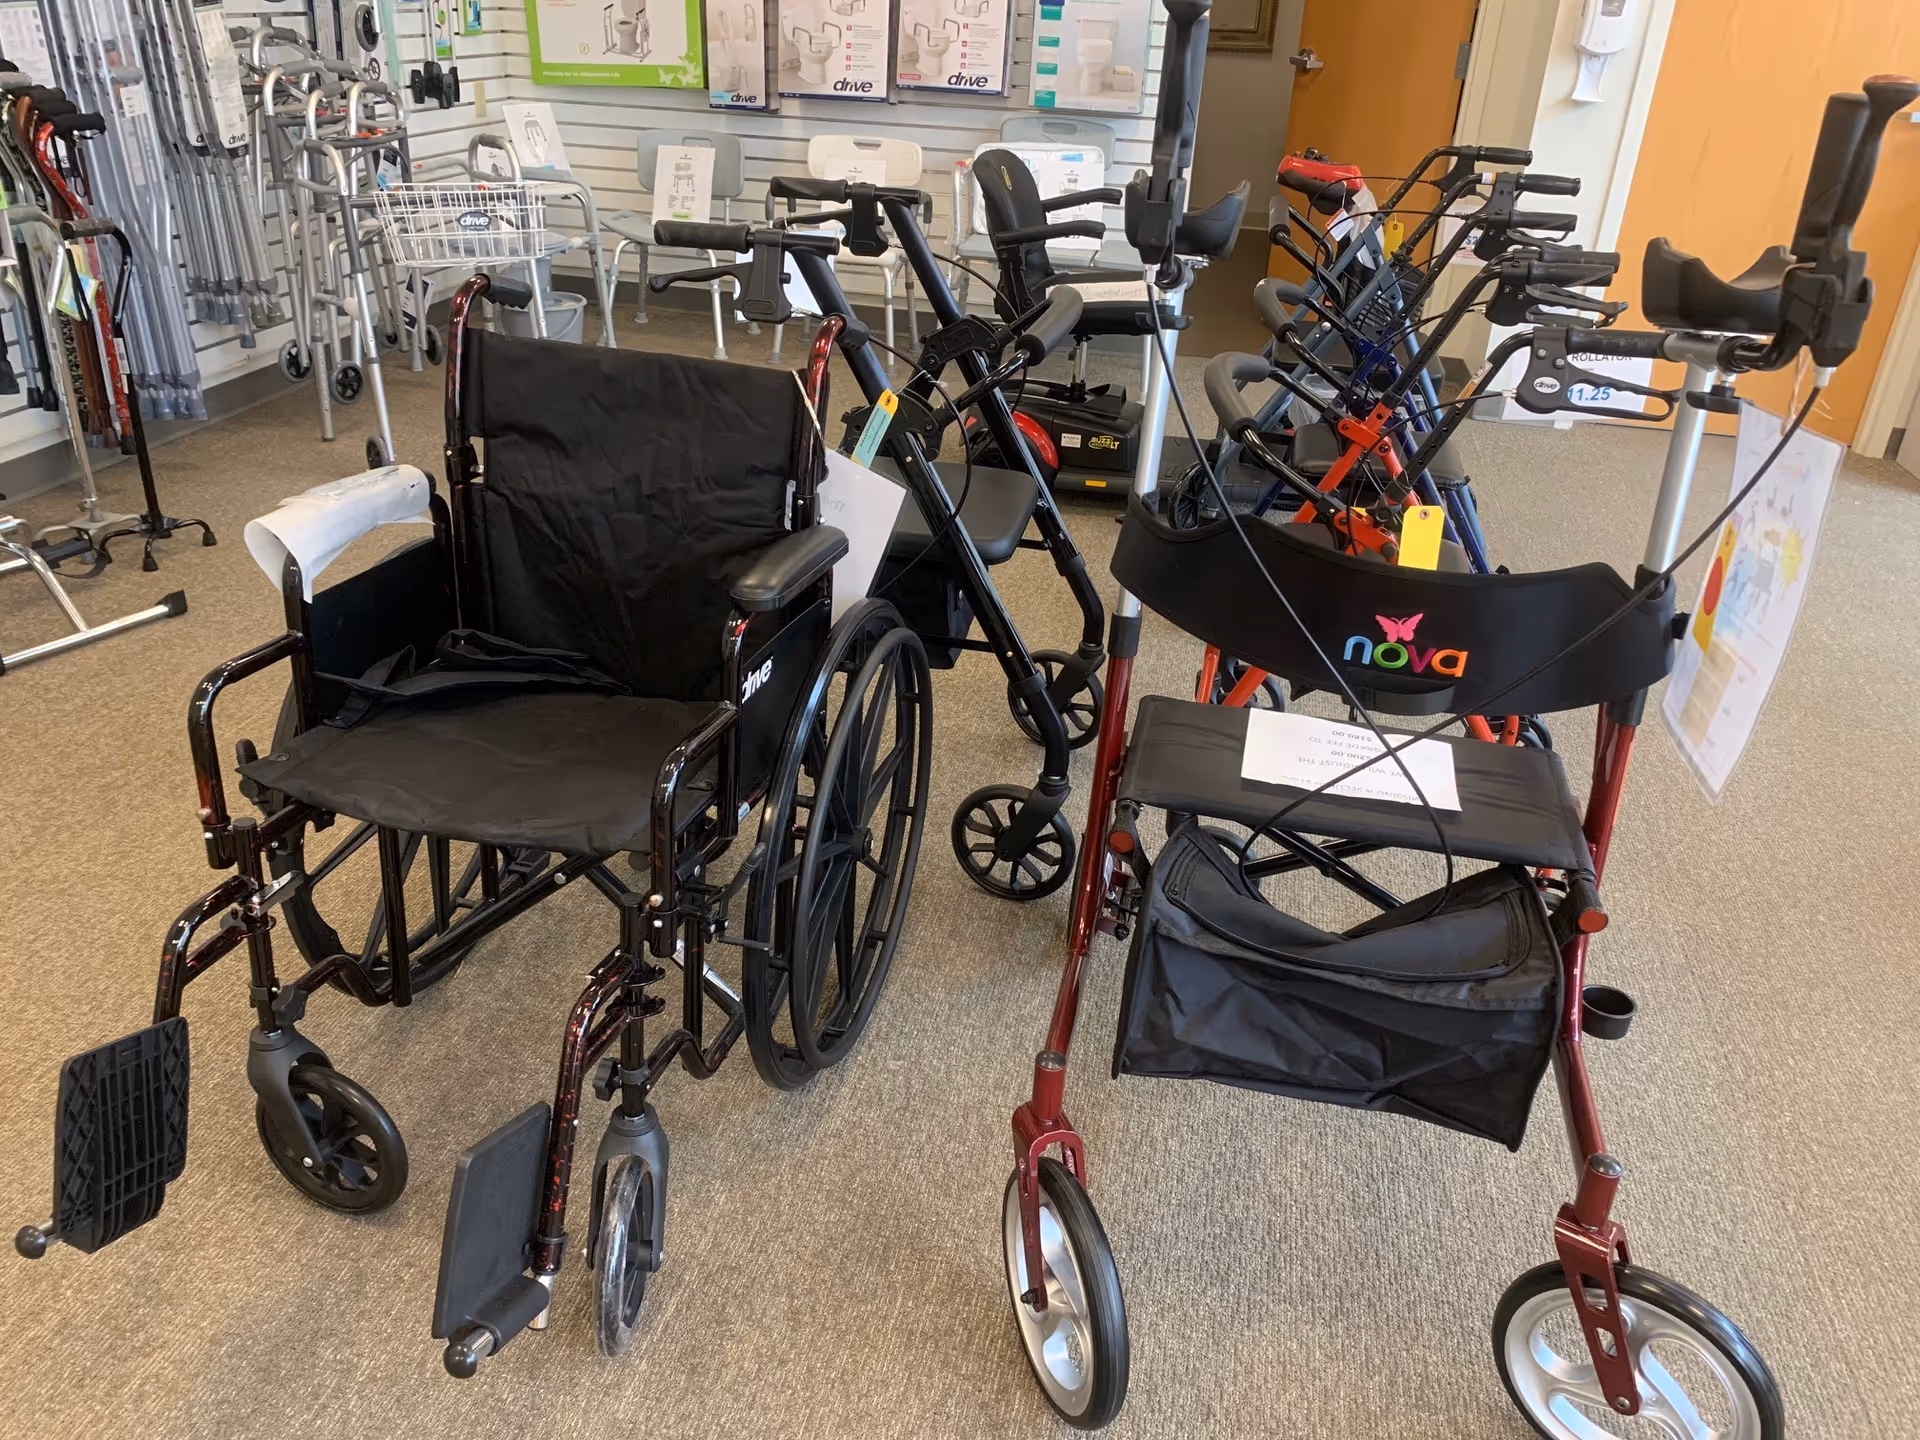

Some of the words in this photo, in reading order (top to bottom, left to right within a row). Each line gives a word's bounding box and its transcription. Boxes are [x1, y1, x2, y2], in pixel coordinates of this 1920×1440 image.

[833, 77, 873, 93] drive
[947, 72, 989, 88] drive
[731, 91, 757, 104] drive
[460, 214, 490, 226] drive
[1343, 635, 1468, 678] nova
